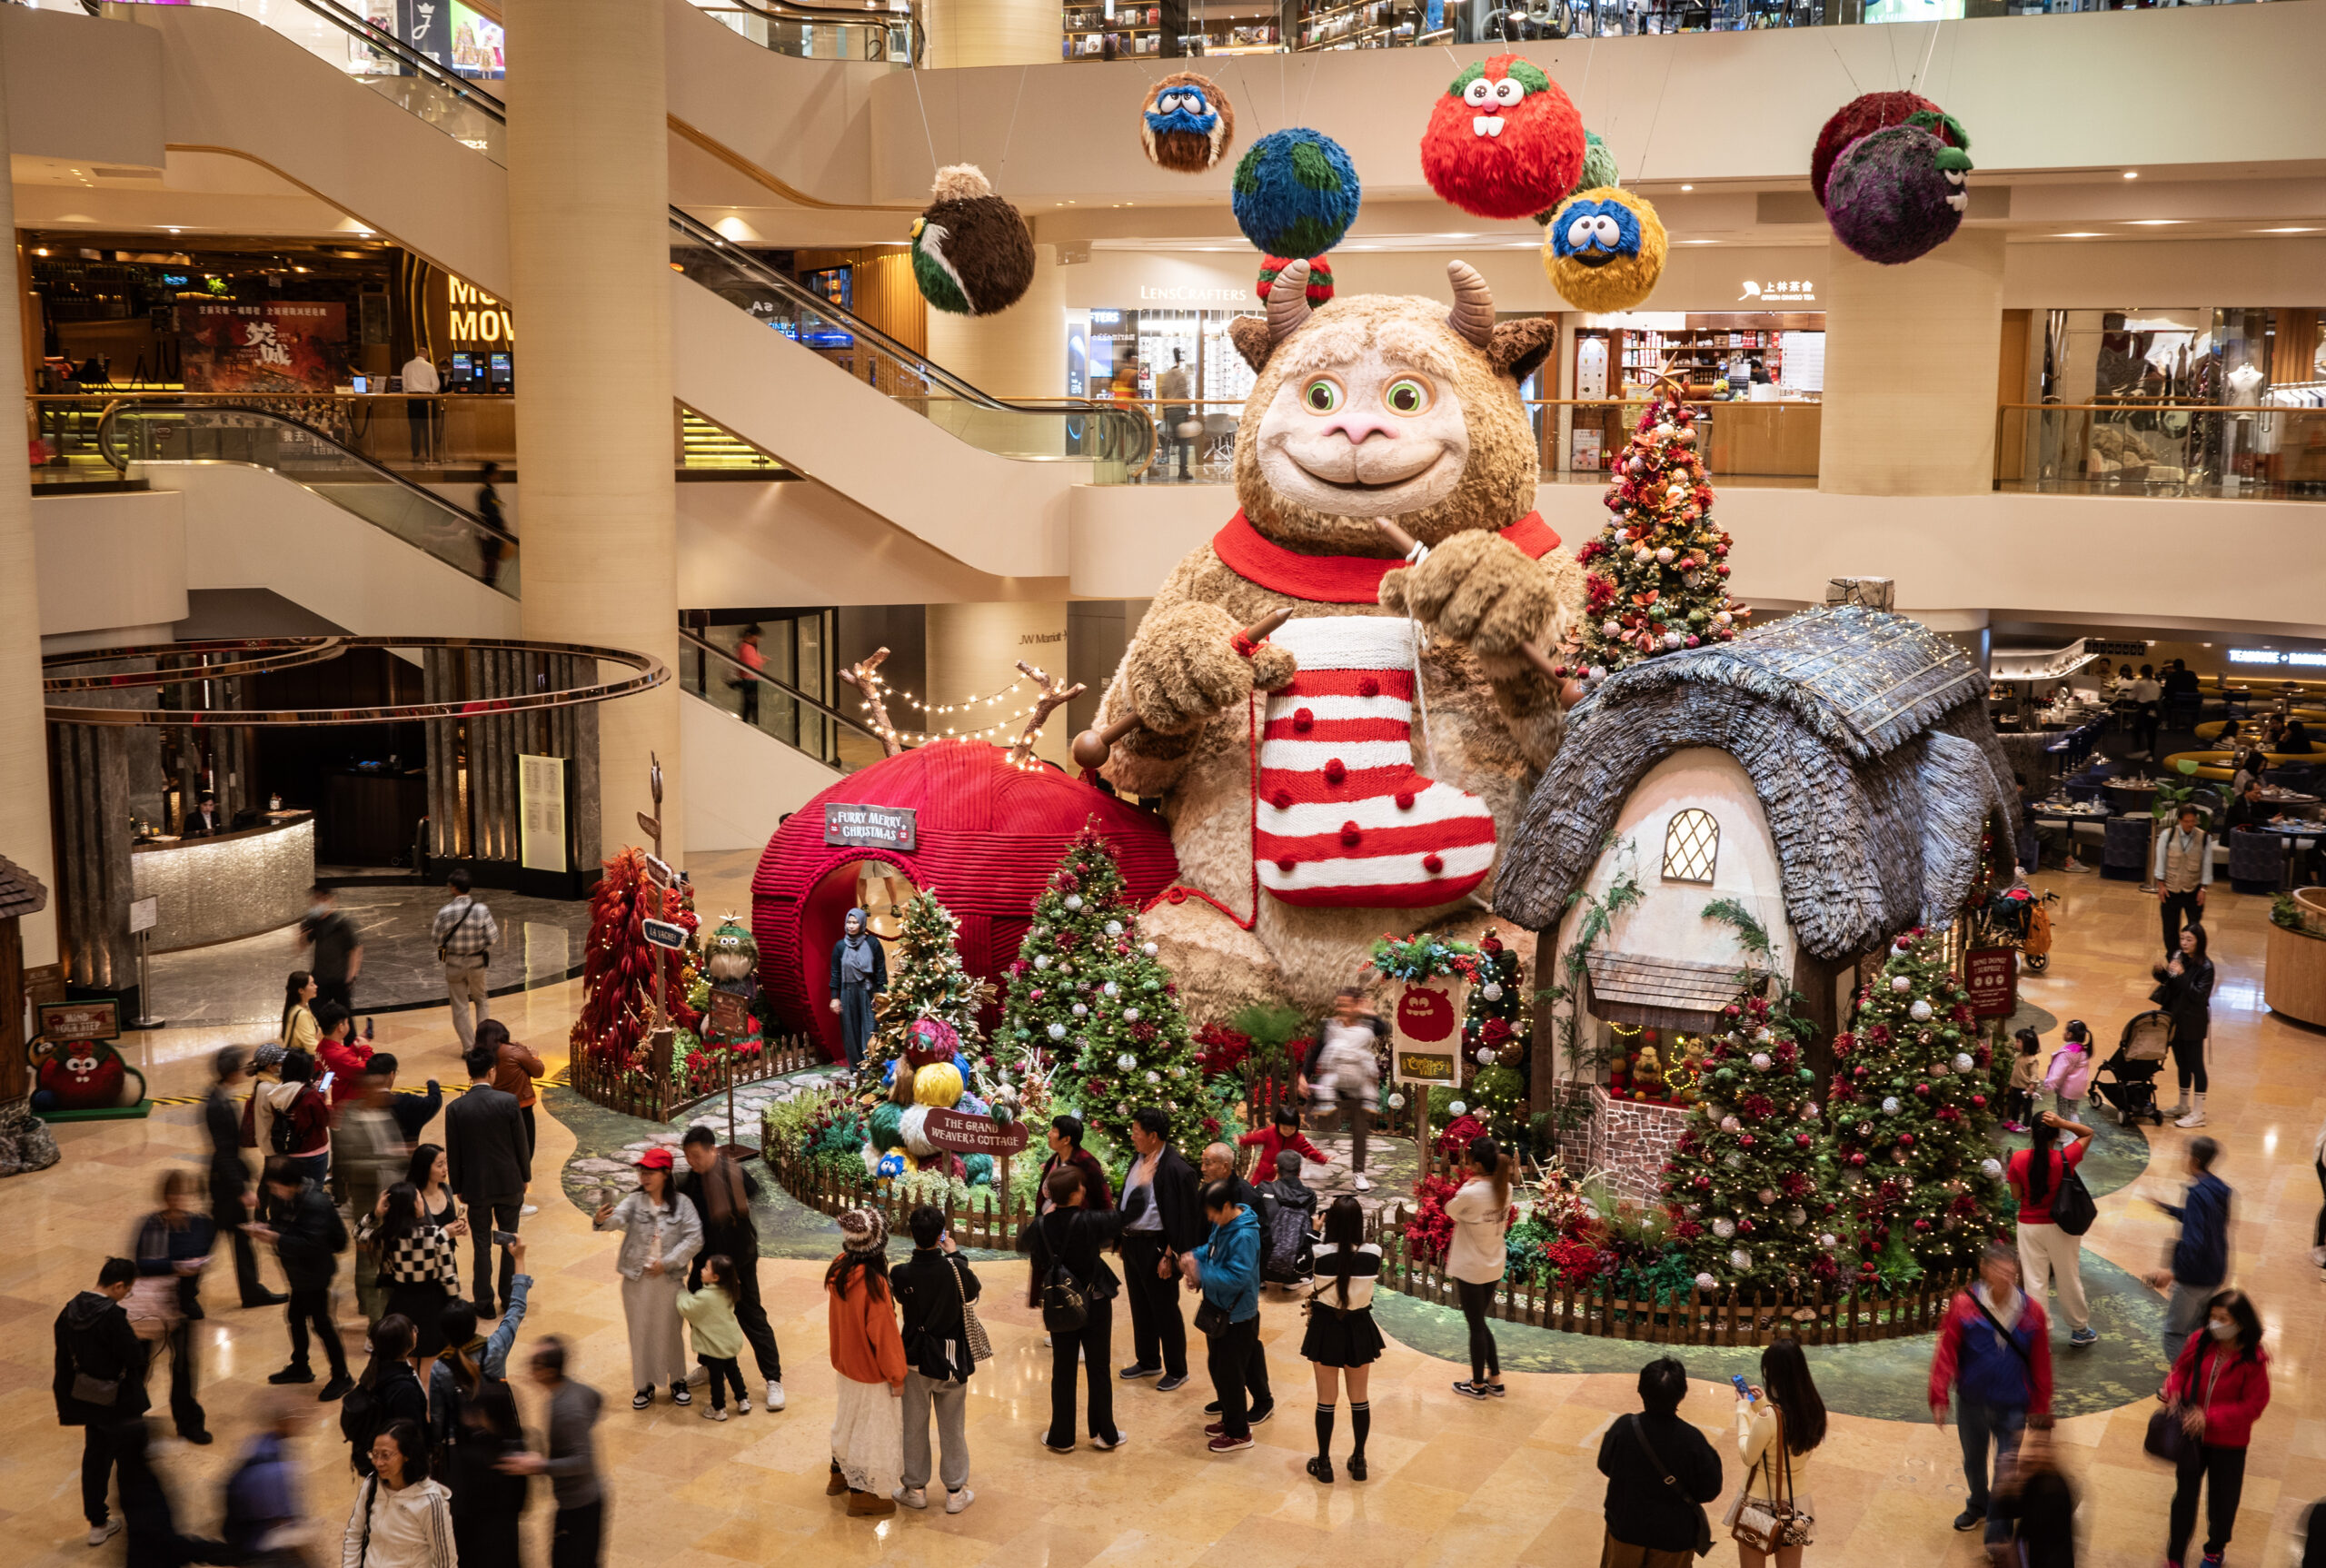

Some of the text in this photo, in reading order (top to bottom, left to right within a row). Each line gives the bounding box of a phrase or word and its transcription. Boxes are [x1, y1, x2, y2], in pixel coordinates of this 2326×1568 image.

[838, 811, 901, 828] FURRY MERRY
[842, 826, 897, 841] CHRISTMAS
[650, 926, 657, 937] LA
[944, 1117, 999, 1134] THE GRAND
[931, 1126, 1019, 1146] WEAVER'S COTTAGE
